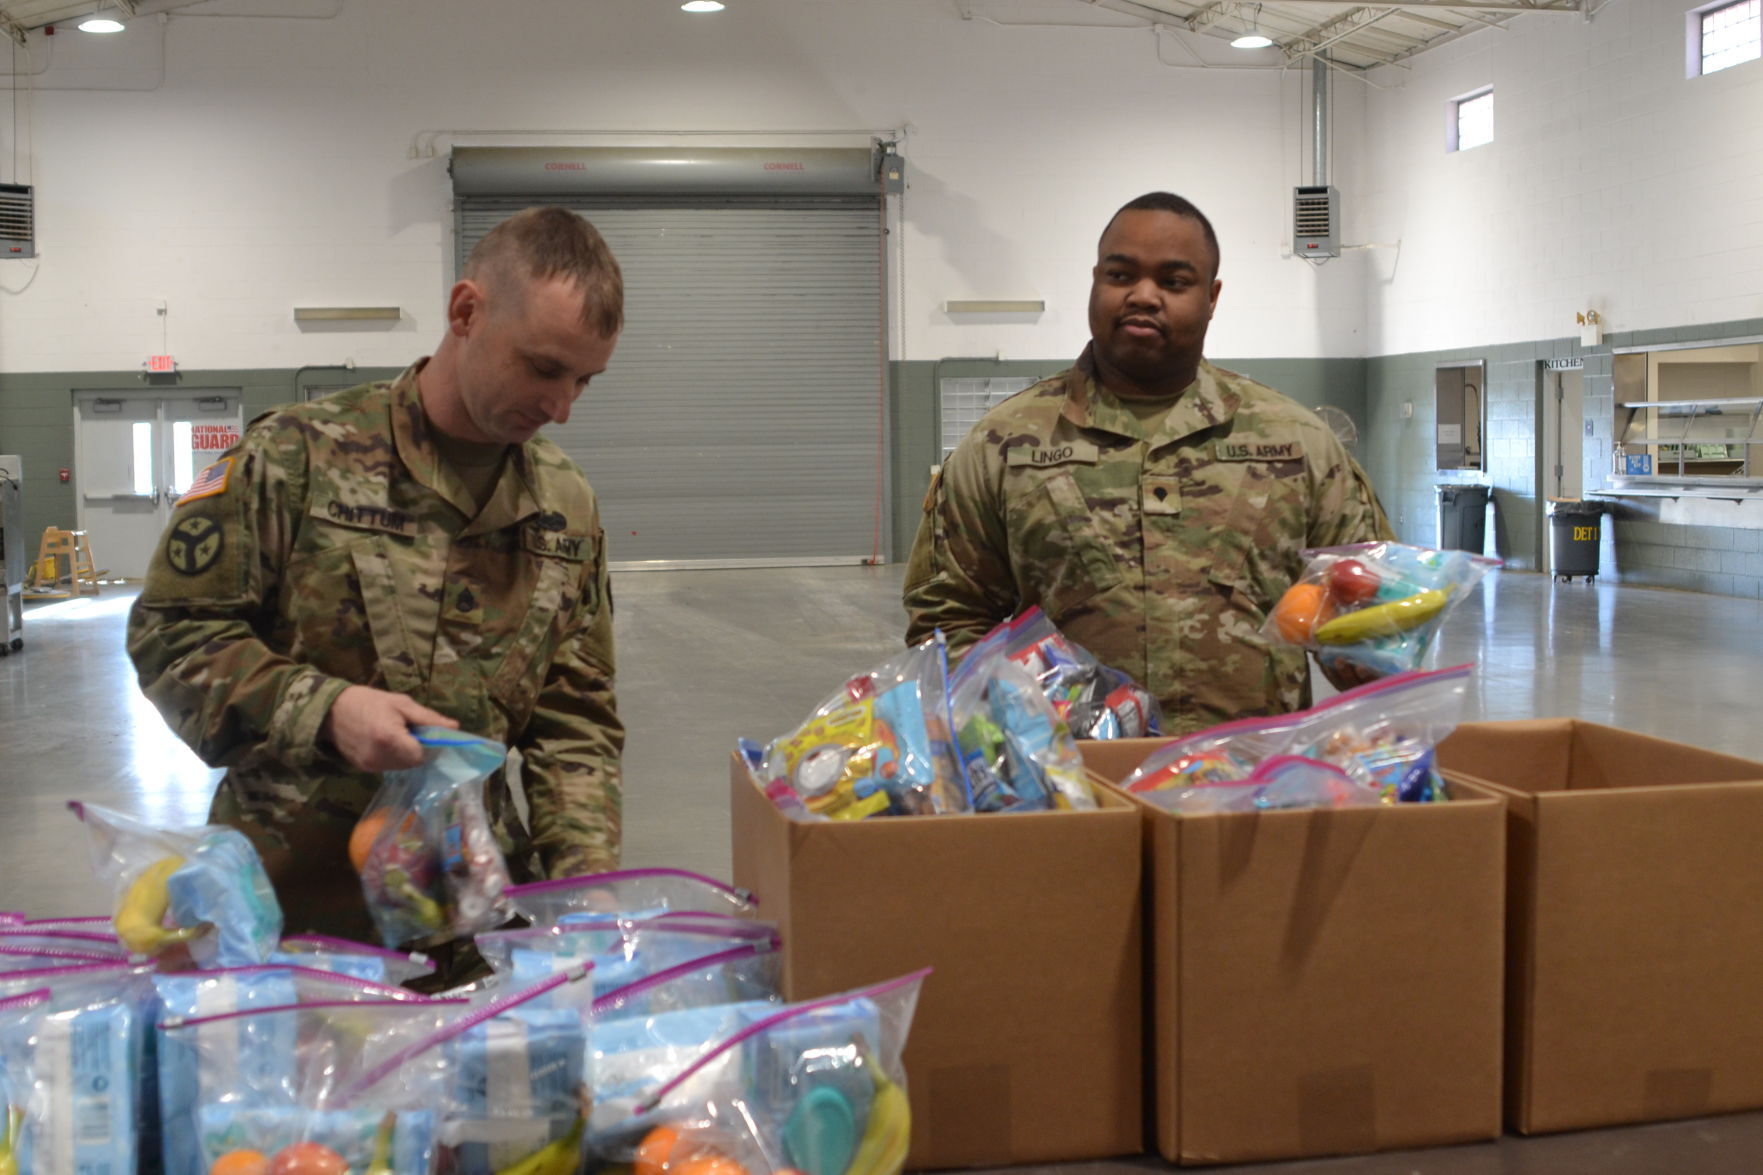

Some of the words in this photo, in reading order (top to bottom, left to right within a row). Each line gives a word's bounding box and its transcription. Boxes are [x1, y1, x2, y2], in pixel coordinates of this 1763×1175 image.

[544, 162, 587, 171] CORNELL
[763, 162, 805, 171] CORNELL
[151, 355, 170, 371] EXIT
[1031, 446, 1073, 464] LINGO
[1227, 445, 1253, 457] U.S.
[1256, 443, 1293, 457] ARMY
[1573, 526, 1593, 541] DET
